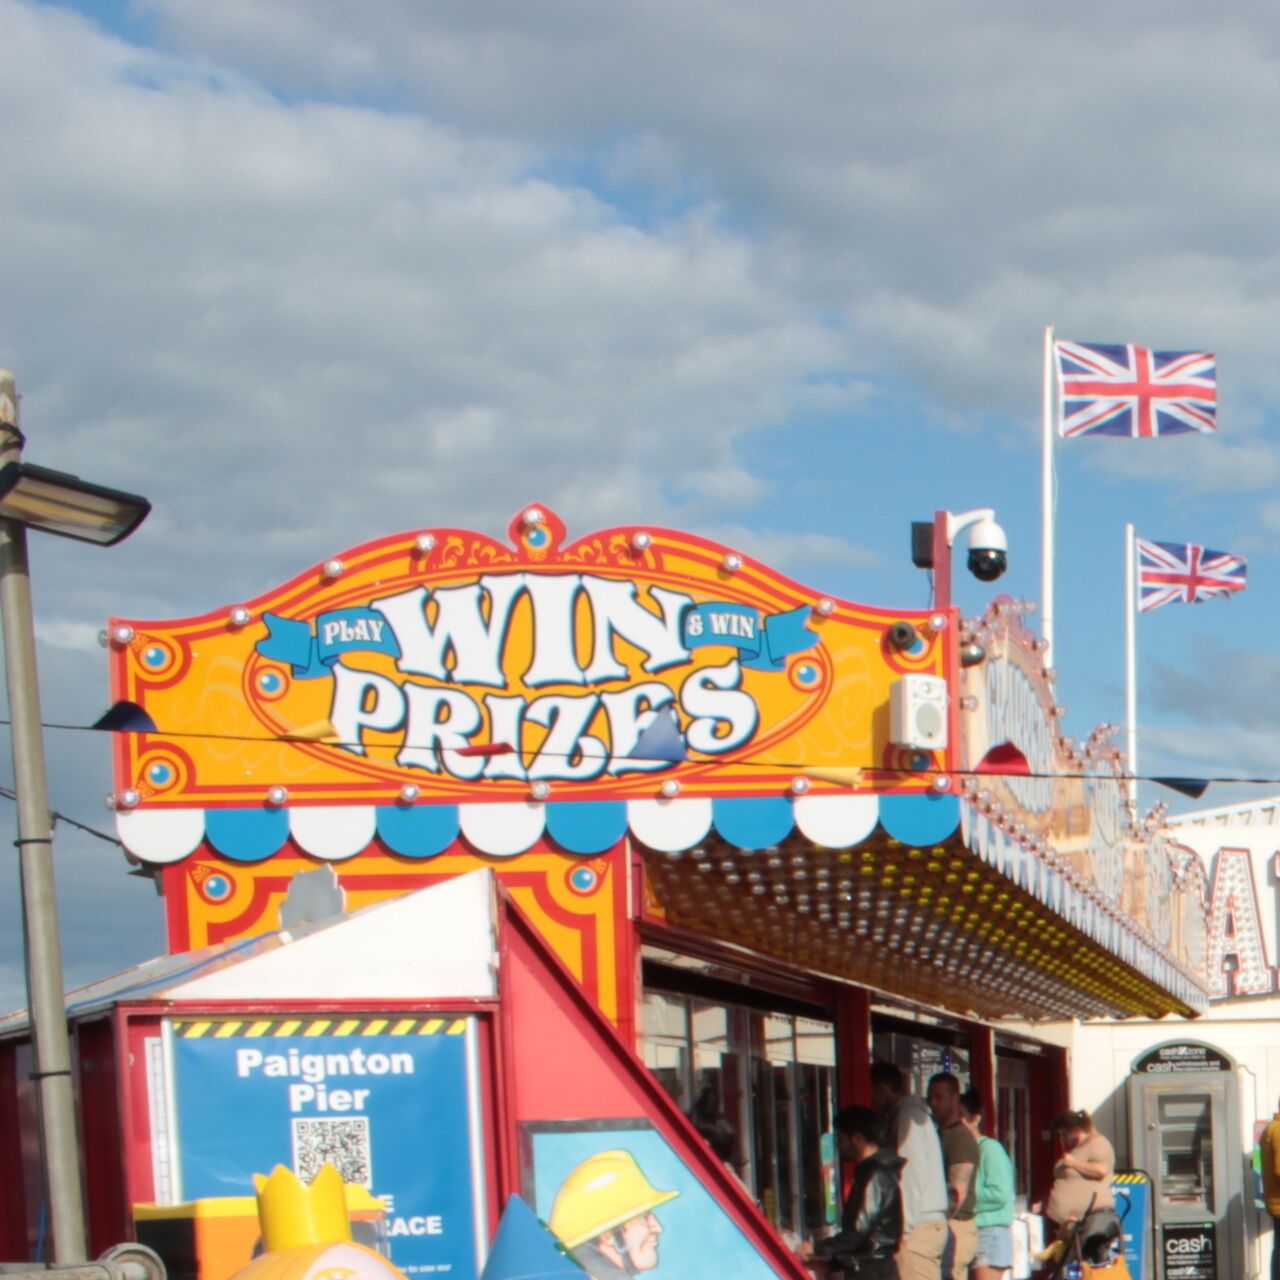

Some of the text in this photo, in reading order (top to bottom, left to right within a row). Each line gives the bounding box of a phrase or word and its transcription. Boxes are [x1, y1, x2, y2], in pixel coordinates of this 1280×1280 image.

[323, 617, 385, 646] PLAY
[370, 572, 698, 687] WIN
[687, 612, 755, 640] & WIN
[330, 659, 759, 782] PRIZES
[237, 1048, 414, 1083] Paignton
[289, 1084, 370, 1112] Pier
[1166, 1234, 1212, 1253] cash
